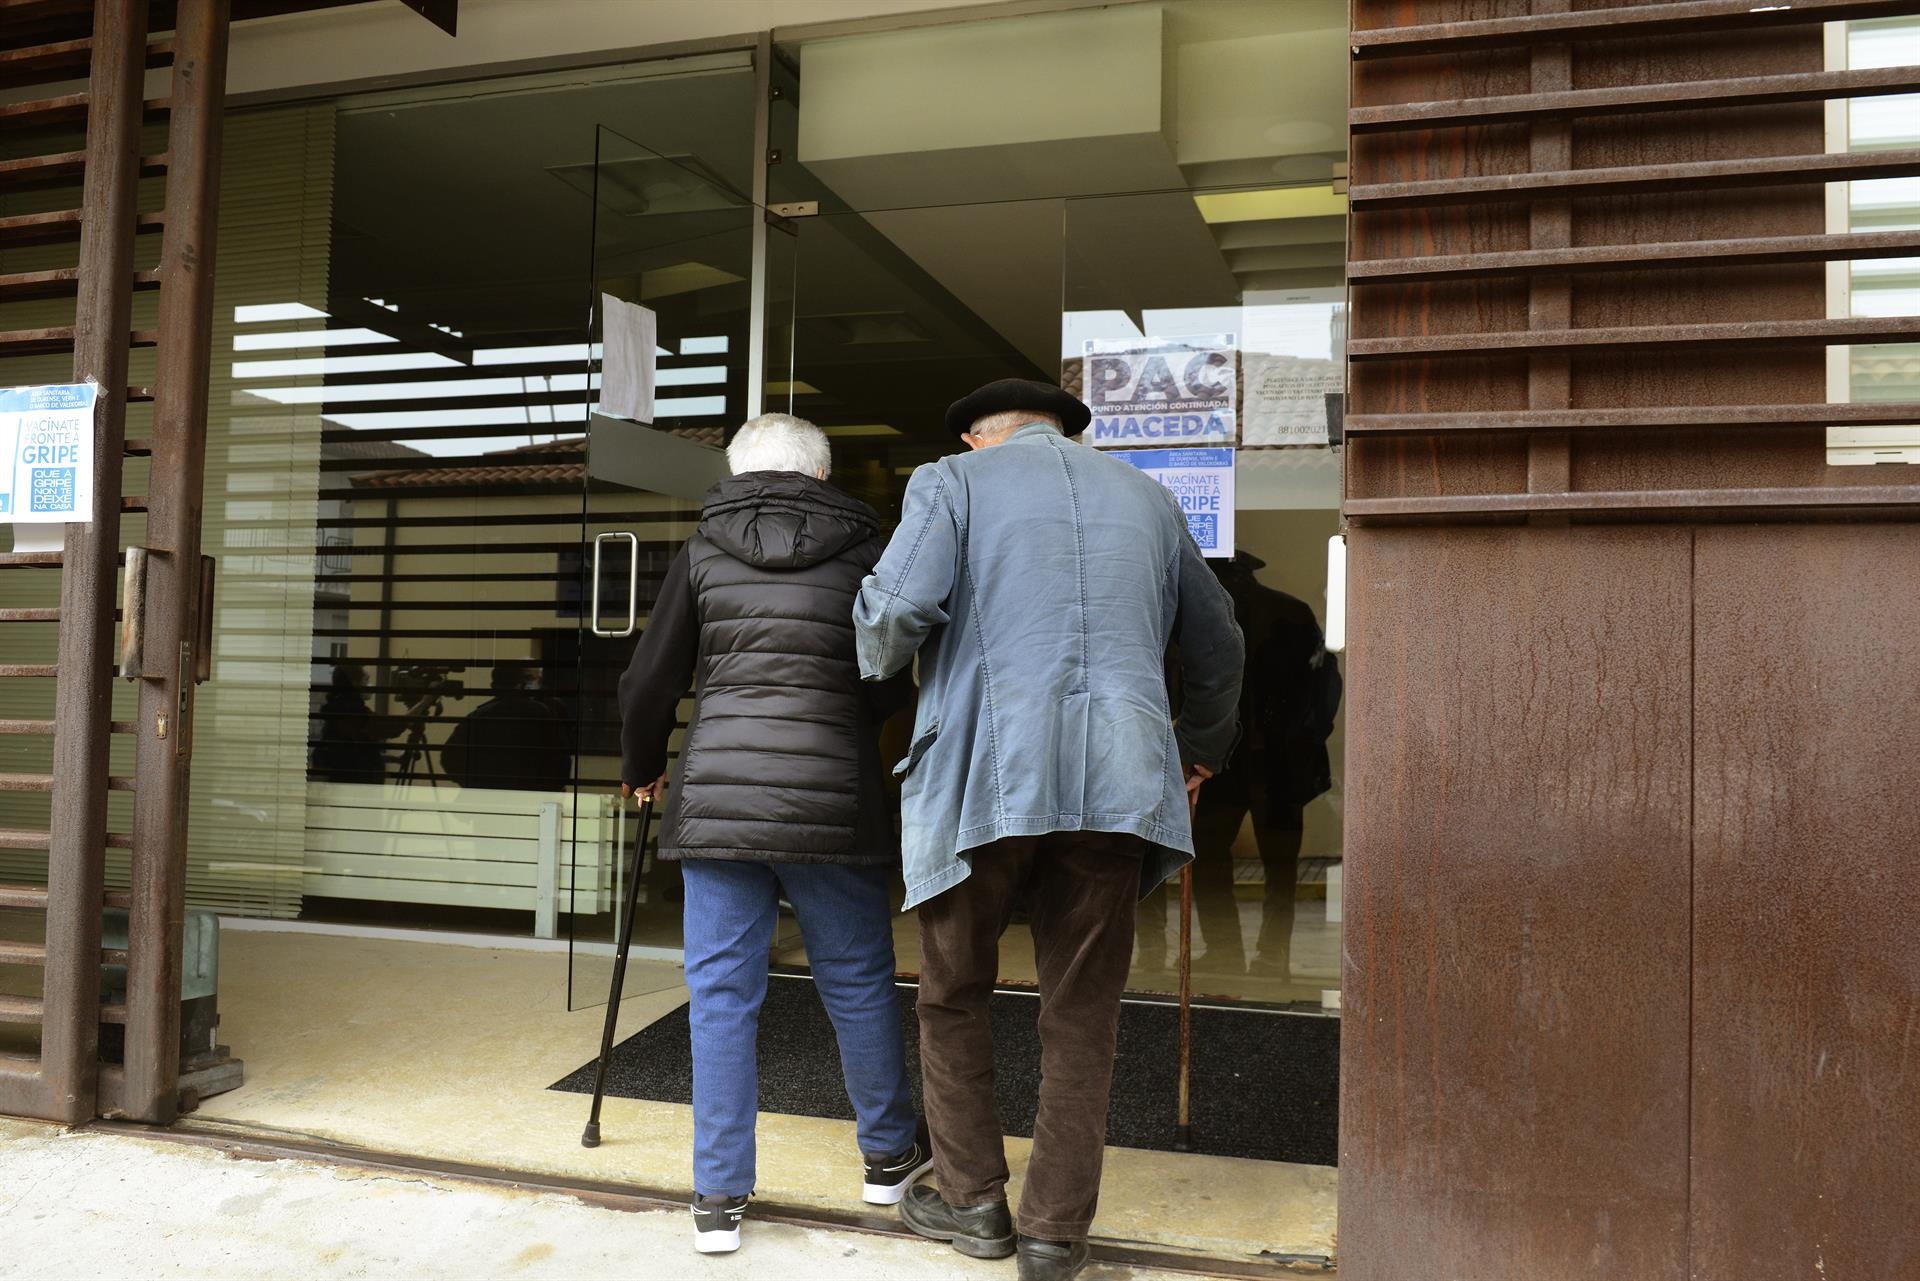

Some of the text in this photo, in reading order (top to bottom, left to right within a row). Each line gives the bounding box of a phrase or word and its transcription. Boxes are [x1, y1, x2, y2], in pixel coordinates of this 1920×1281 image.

[1091, 353, 1228, 404] PAC
[1092, 401, 1228, 413] PUNTO ATENCIÓN CONTINUADA
[25, 417, 79, 432] VACÍNATE
[1095, 413, 1226, 439] MACEDA
[23, 432, 80, 445] FRONTE A
[22, 444, 78, 464] GRIPE
[34, 470, 61, 478] QUE
[1167, 473, 1220, 485] VACÍNATE
[34, 478, 72, 487] GRIPE
[1213, 486, 1220, 494] A
[34, 495, 72, 503] DEIXE
[1175, 496, 1220, 510] RIPE
